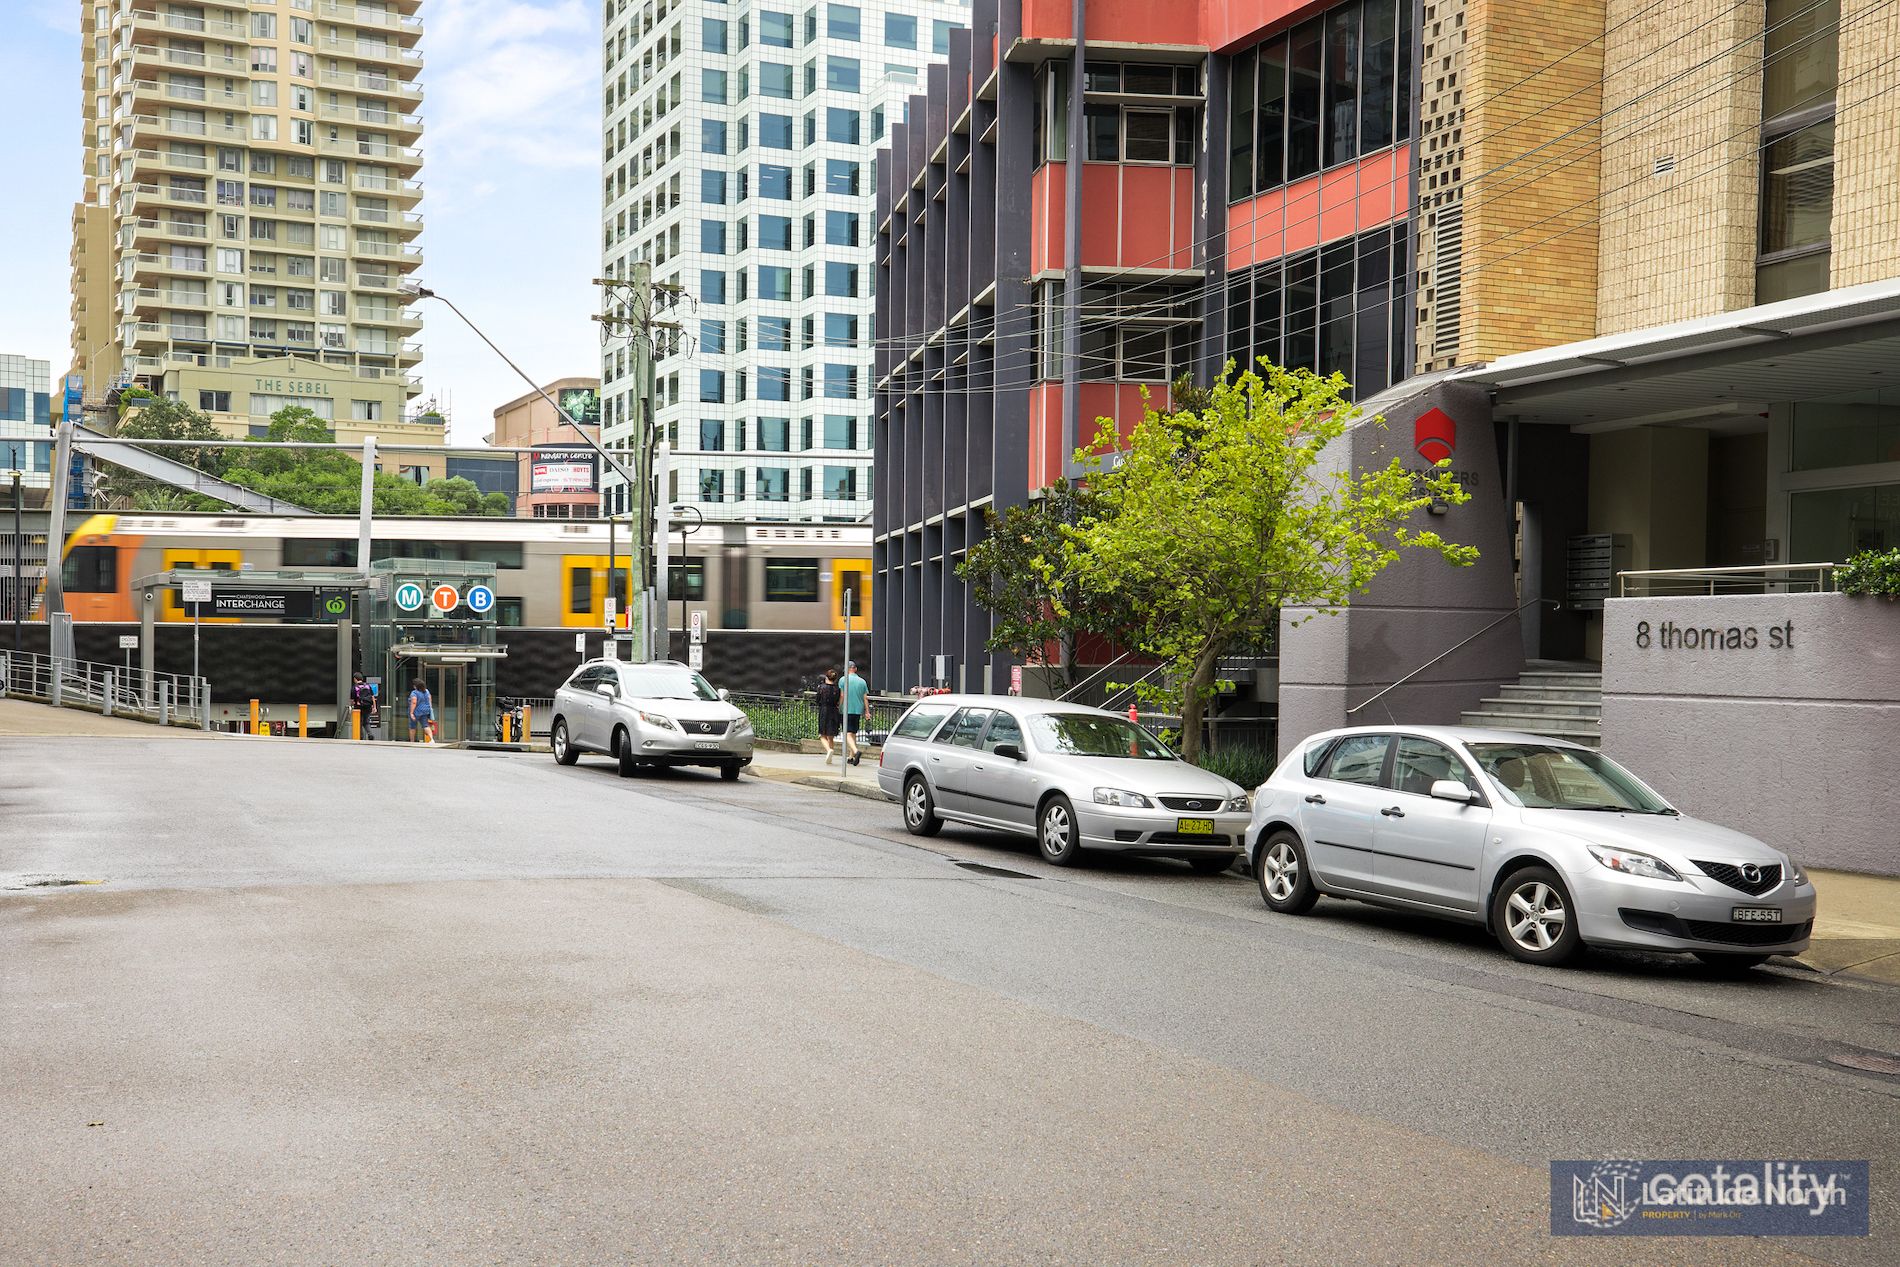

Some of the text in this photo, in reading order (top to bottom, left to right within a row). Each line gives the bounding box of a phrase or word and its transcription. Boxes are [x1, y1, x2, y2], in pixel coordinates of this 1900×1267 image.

[255, 379, 329, 395] THE SEBEL
[216, 599, 285, 609] INTERCHANGE
[401, 589, 487, 607] M T B
[1636, 619, 1794, 650] 8 thomas st
